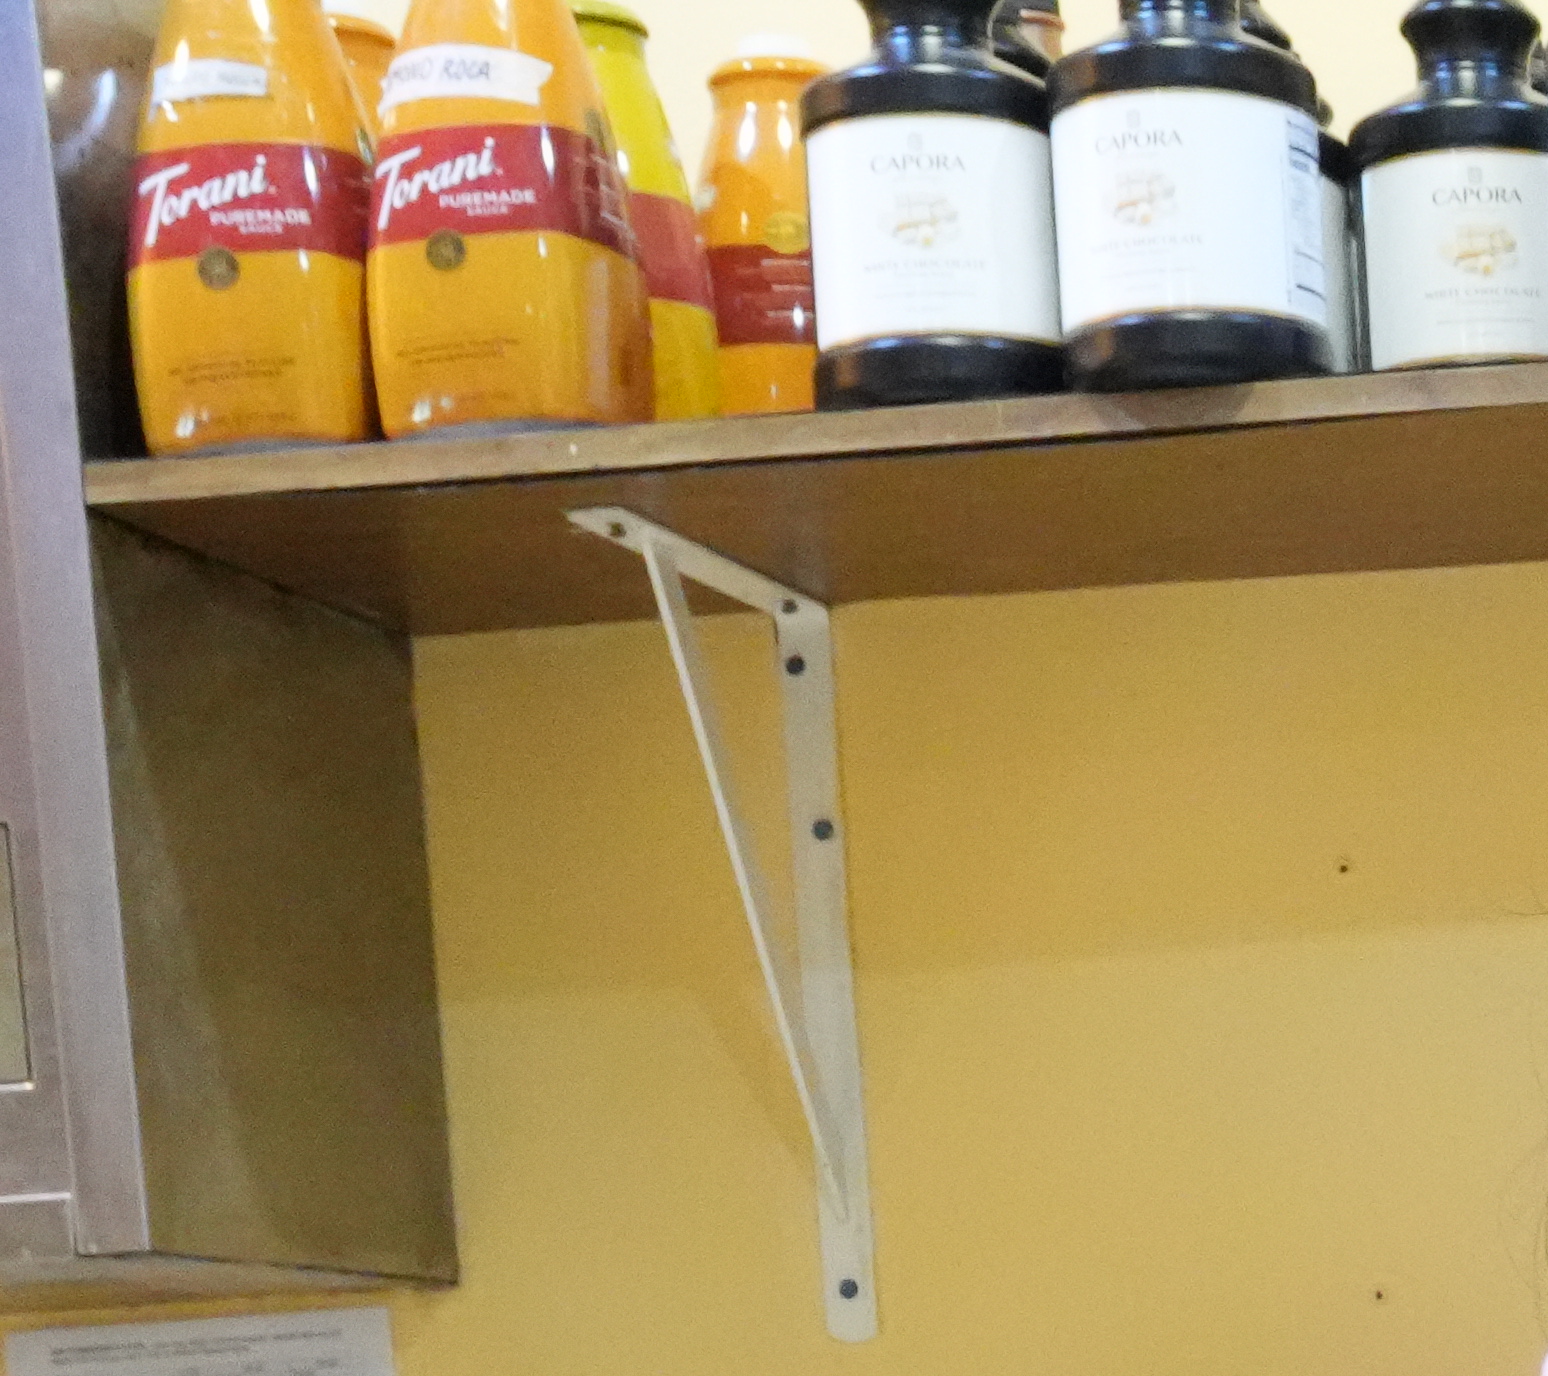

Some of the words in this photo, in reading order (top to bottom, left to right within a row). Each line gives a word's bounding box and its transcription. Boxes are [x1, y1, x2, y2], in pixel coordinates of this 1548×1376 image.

[1095, 129, 1184, 155] CAPORA
[869, 152, 967, 175] CAPORA
[375, 135, 495, 231] Torani
[1431, 185, 1523, 206] CAPORA
[138, 153, 268, 248] Torani
